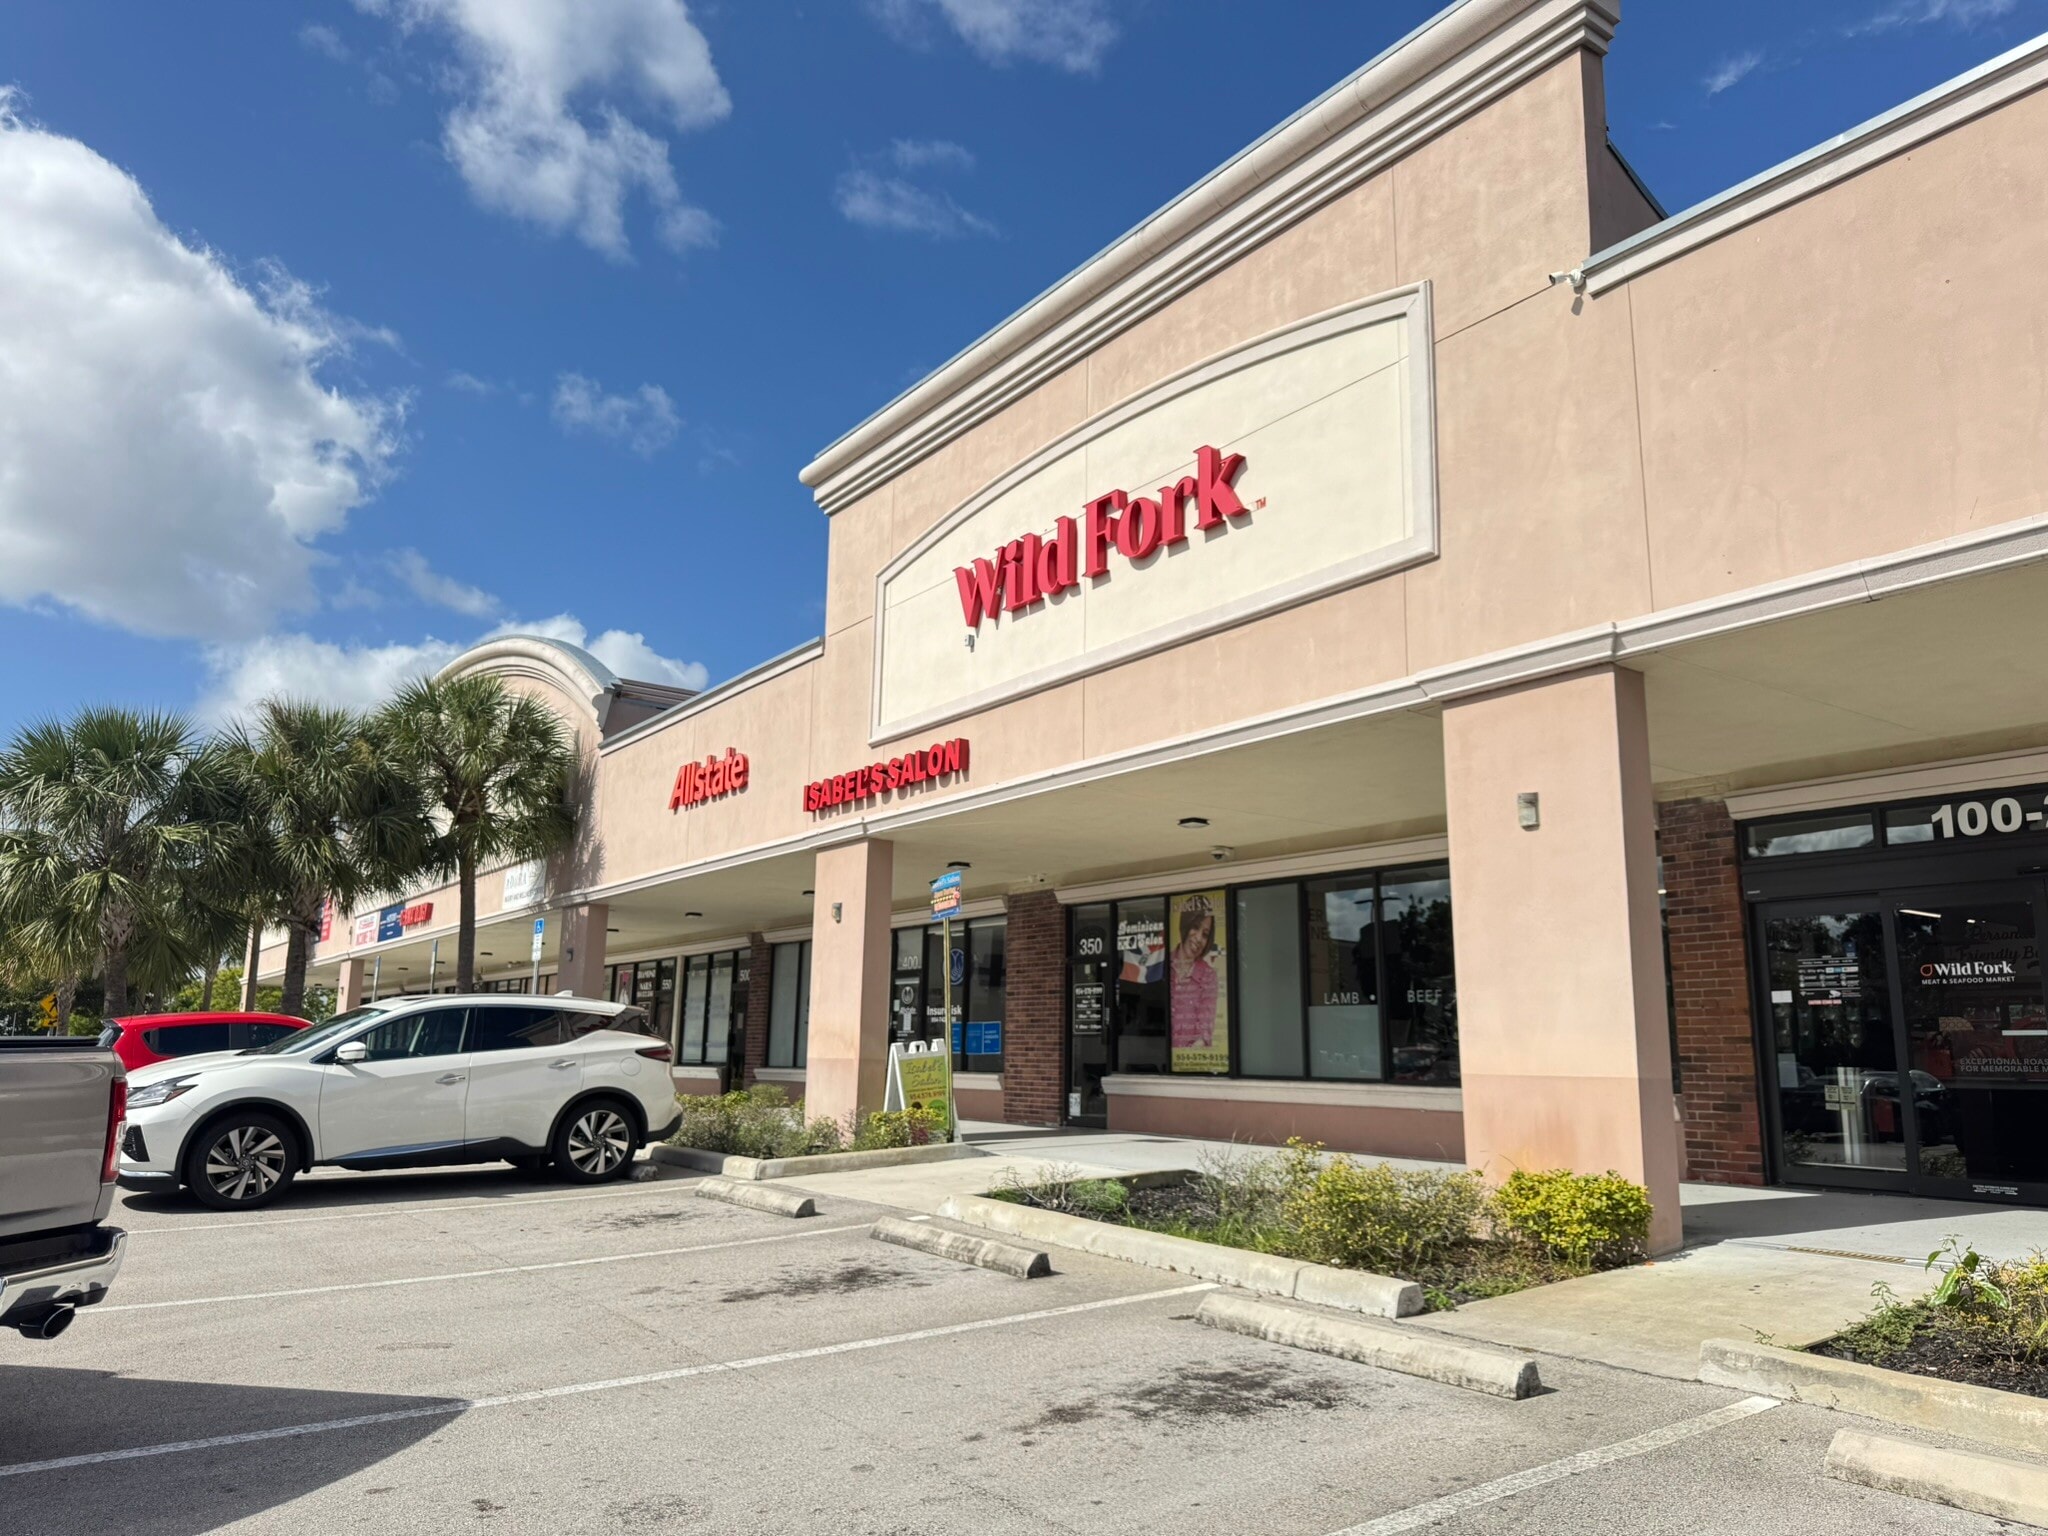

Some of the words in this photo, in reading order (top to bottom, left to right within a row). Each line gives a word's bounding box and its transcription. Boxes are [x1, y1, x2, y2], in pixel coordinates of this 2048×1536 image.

[952, 515, 1079, 627] Wild
[1082, 445, 1250, 578] Fork
[668, 747, 749, 810] Allstate
[803, 763, 887, 812] ISABEL'S
[886, 738, 969, 790] SALON
[1931, 795, 2048, 838] 100-
[1117, 920, 1164, 936] Dominican
[1080, 938, 1103, 955] 350
[1137, 933, 1164, 947] Salon
[902, 956, 919, 970] 400
[1933, 962, 1972, 976] Wild
[1973, 960, 2014, 975] Fork
[661, 979, 673, 990] 550
[1324, 992, 1360, 1005] LAMB
[1406, 989, 1443, 1003] BEEF
